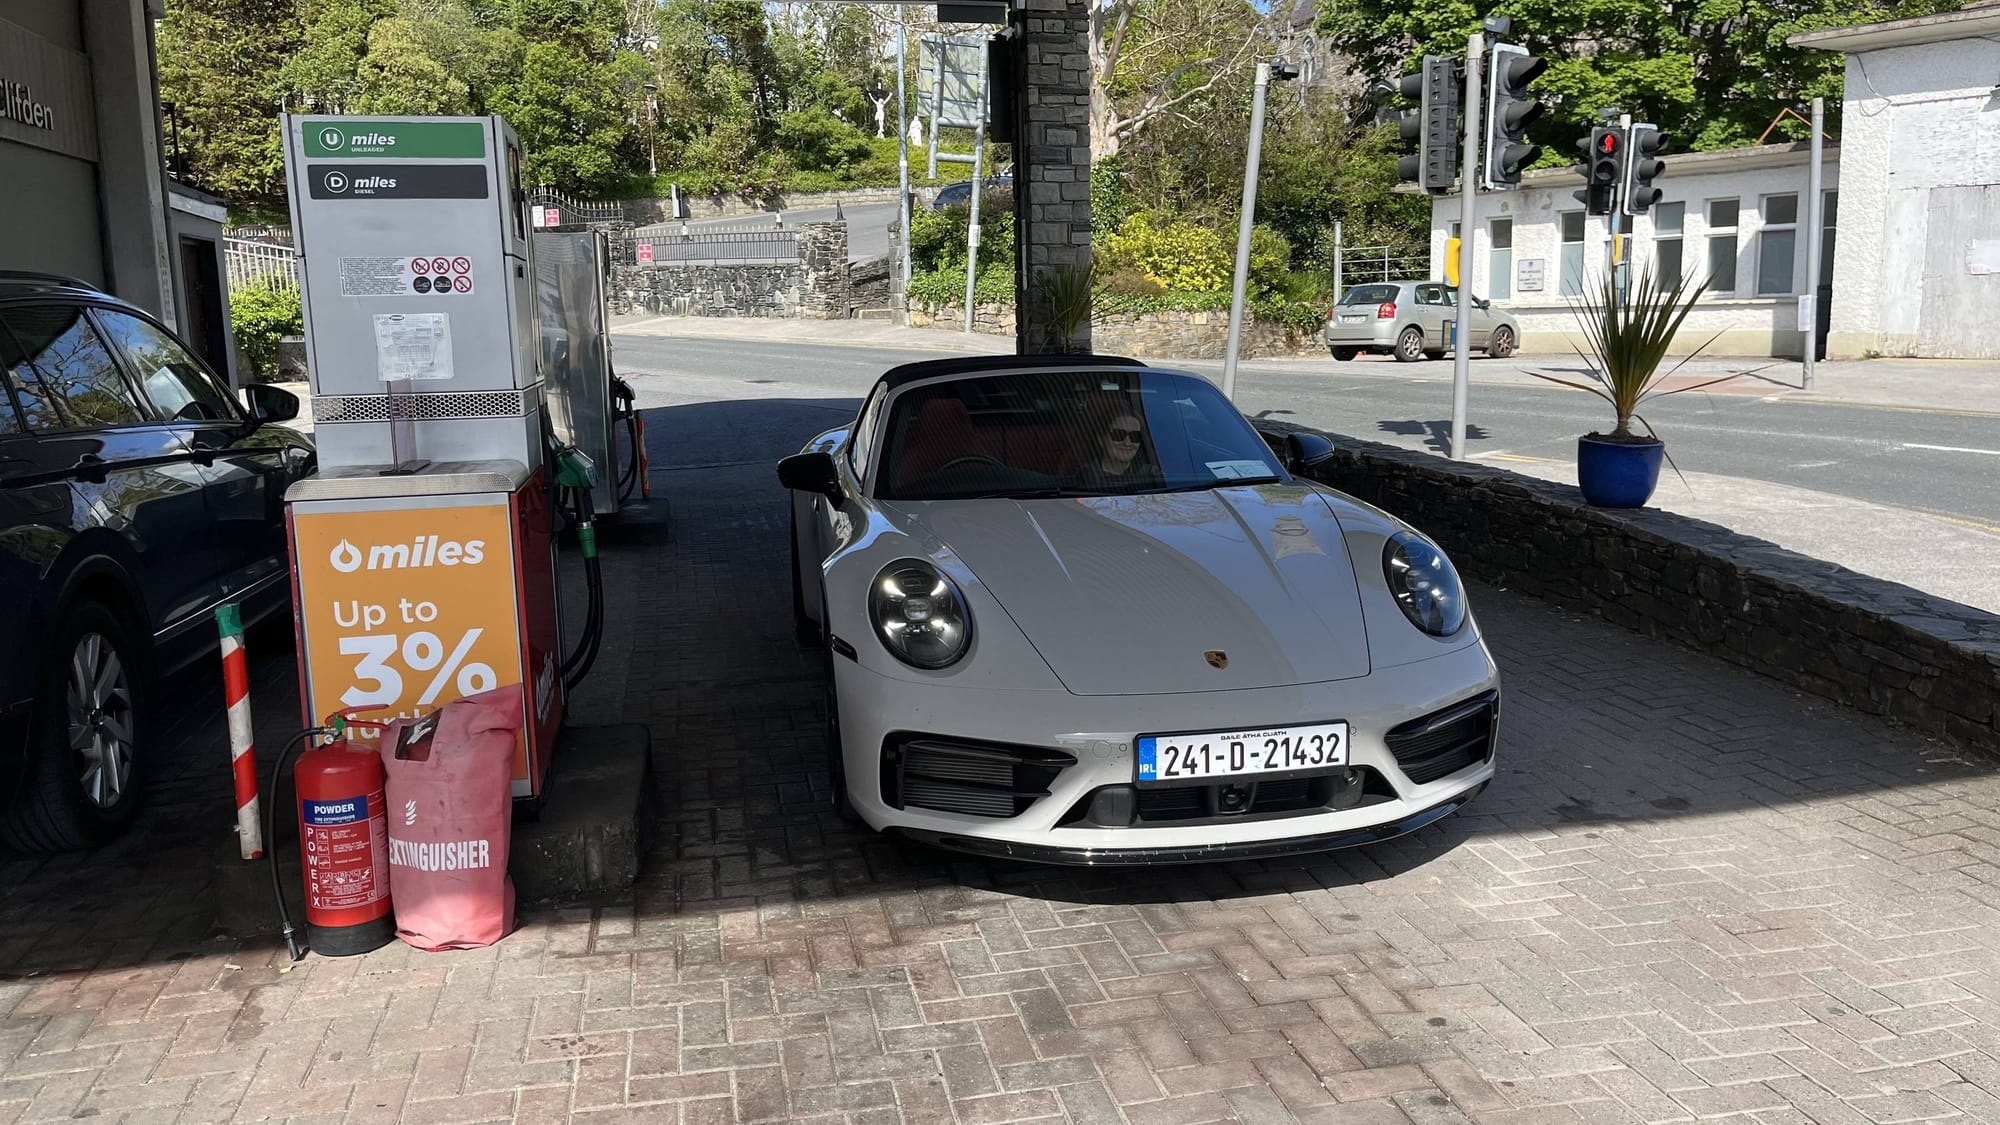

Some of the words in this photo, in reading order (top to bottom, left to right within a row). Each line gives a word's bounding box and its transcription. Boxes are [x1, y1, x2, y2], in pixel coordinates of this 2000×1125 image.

[325, 133, 338, 145] U
[351, 133, 396, 145] miles
[330, 177, 343, 188] D
[354, 176, 397, 188] miles
[367, 535, 485, 570] miles
[333, 600, 386, 631] Up
[399, 598, 438, 623] to
[338, 628, 497, 708] 3%
[1139, 764, 1156, 774] IRL
[1164, 732, 1340, 777] 241-D-21432
[314, 803, 355, 814] POWDER
[389, 836, 490, 872] EXTINGUISHER
